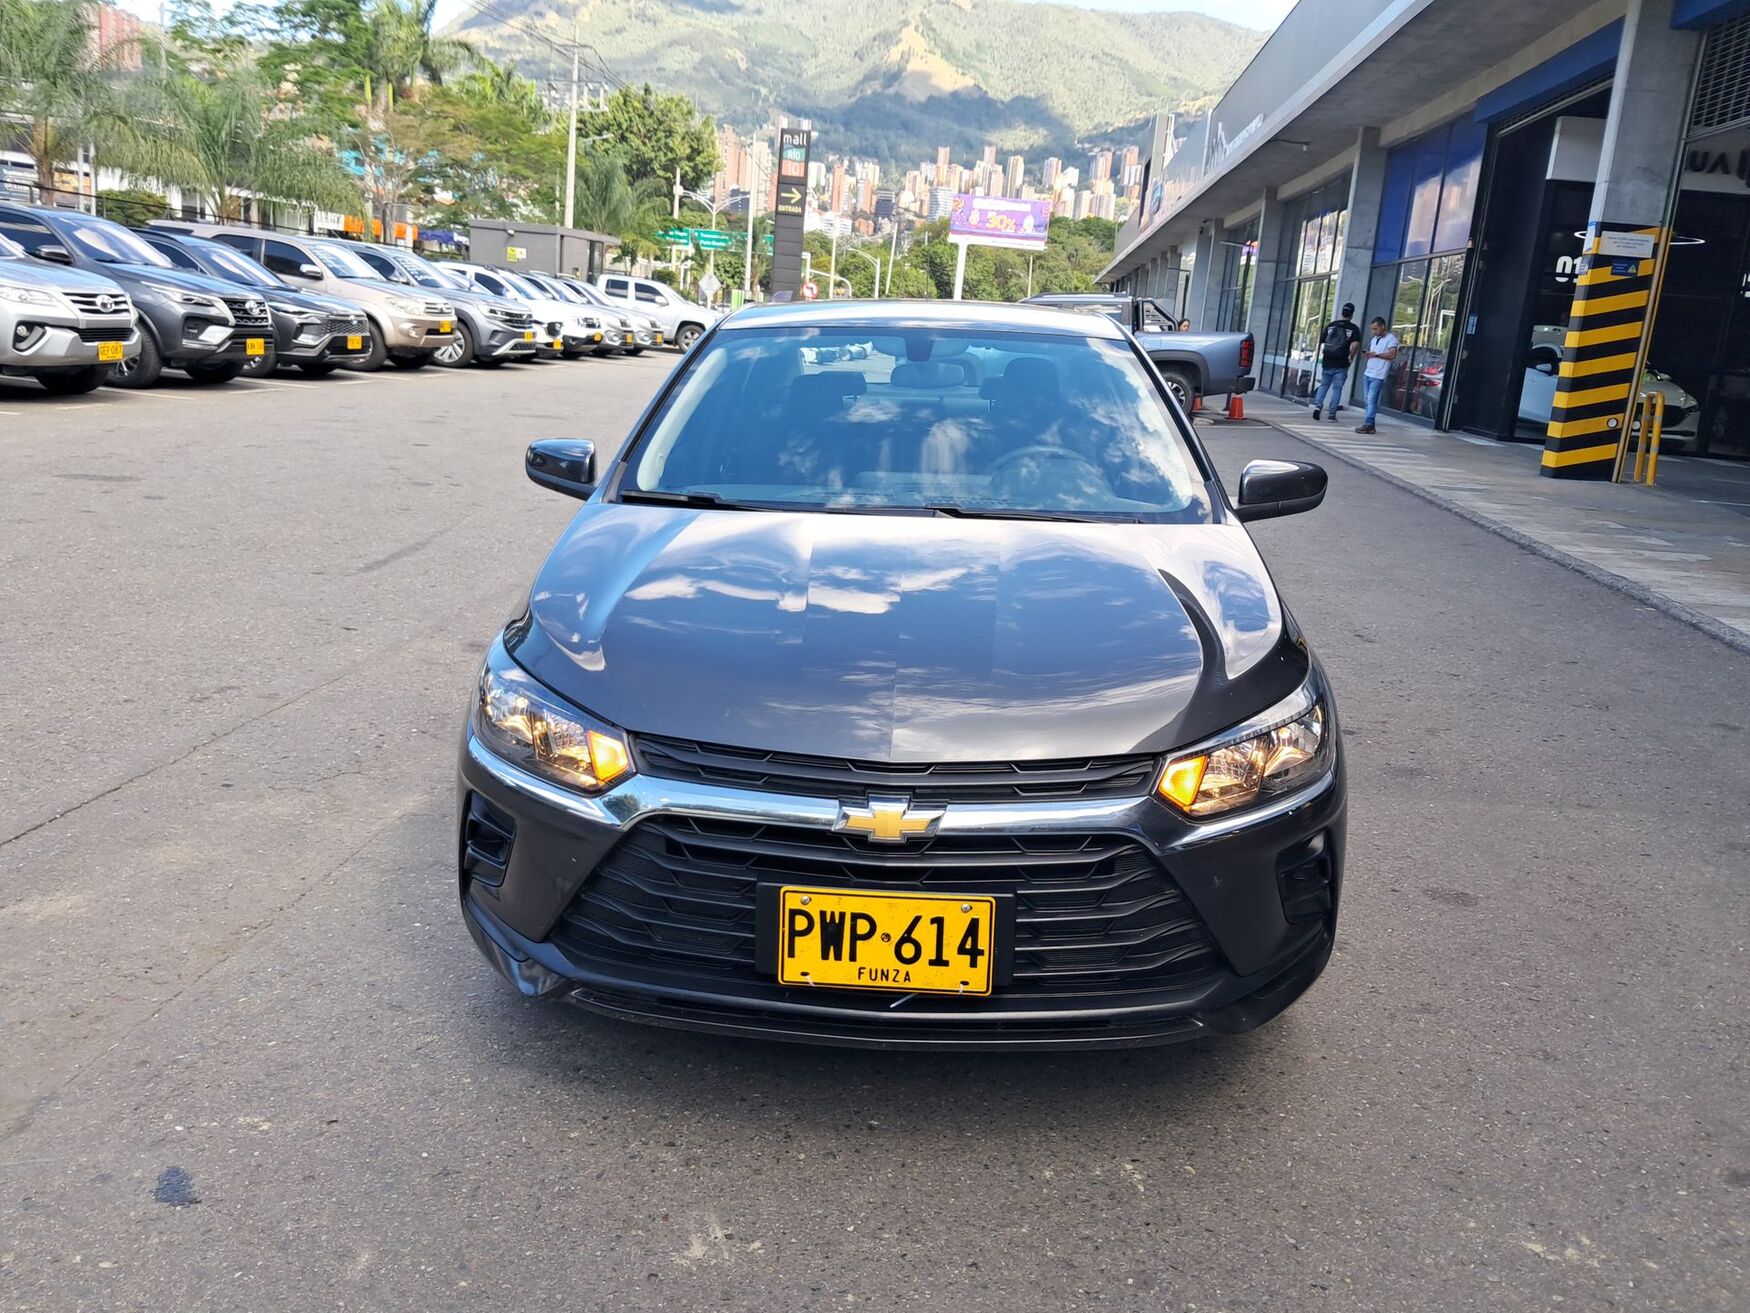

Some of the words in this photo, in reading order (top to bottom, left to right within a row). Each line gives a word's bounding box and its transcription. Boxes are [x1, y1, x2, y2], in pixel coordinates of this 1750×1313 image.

[783, 132, 807, 146] mall
[778, 204, 803, 213] ENTRADA
[857, 966, 911, 983] FUNZA
